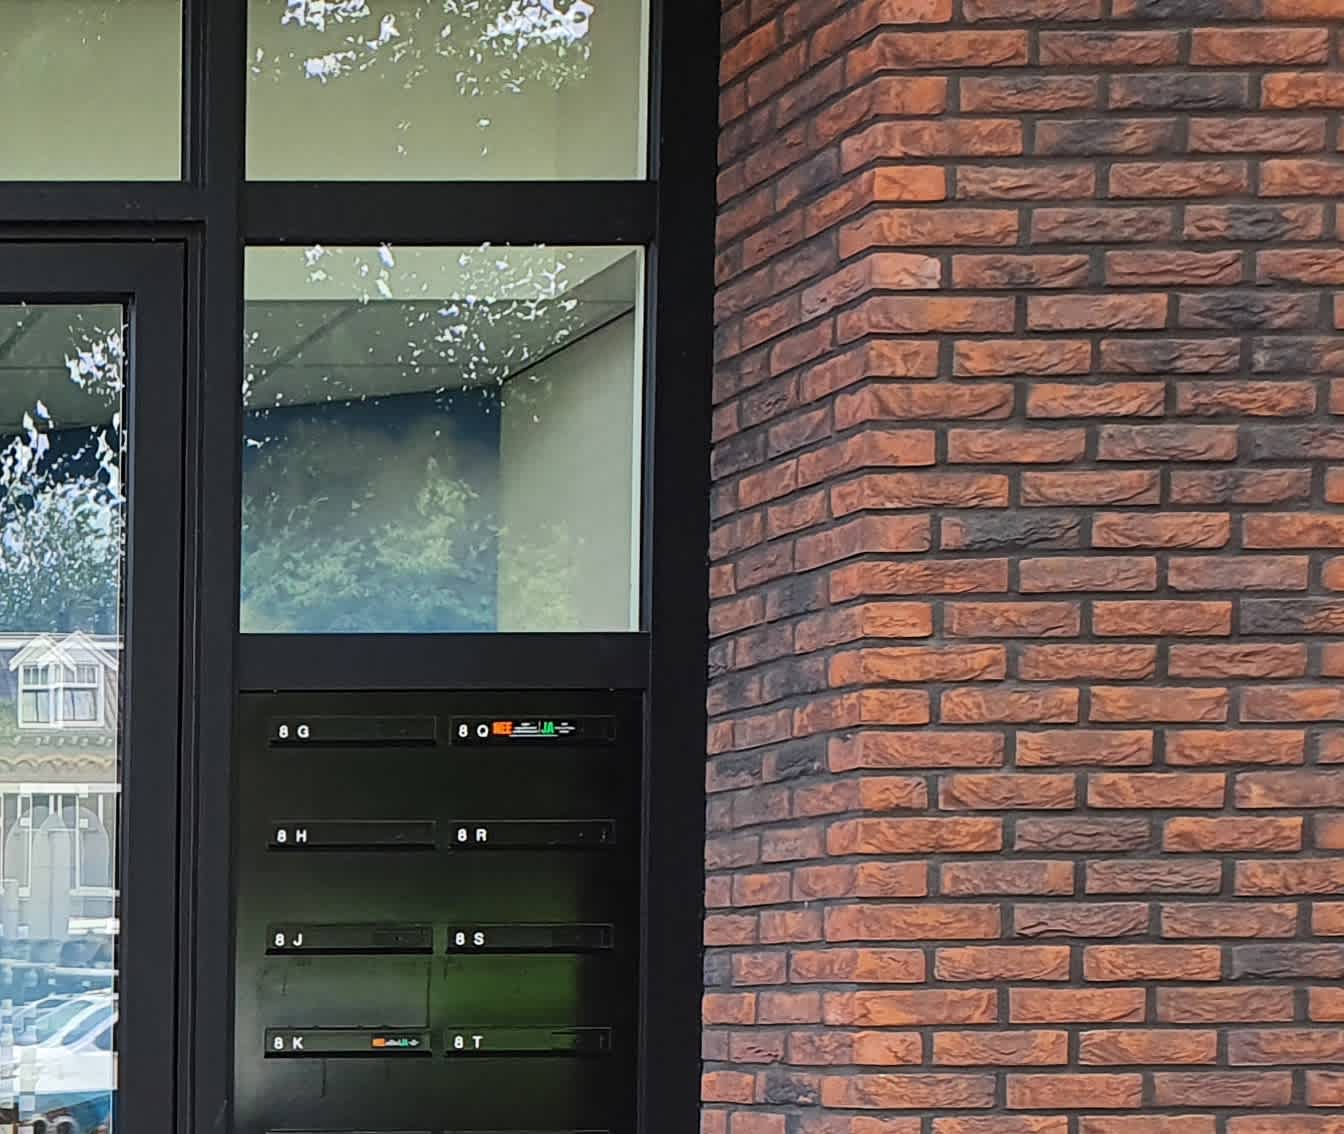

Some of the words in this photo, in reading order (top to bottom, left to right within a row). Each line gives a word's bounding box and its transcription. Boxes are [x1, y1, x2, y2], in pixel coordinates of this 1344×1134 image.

[278, 724, 289, 739] 8
[297, 724, 310, 738] G
[458, 724, 468, 738] 8
[476, 724, 489, 738] Q
[276, 829, 287, 843] 8
[295, 829, 307, 843] H
[457, 828, 468, 842] 8
[476, 828, 487, 842] R
[274, 933, 285, 947] 8
[292, 933, 303, 947] J
[455, 932, 465, 946] 8
[473, 932, 485, 946] S
[273, 1036, 284, 1050] 8
[292, 1036, 304, 1050] K
[454, 1035, 464, 1049] 8
[472, 1035, 483, 1049] T
